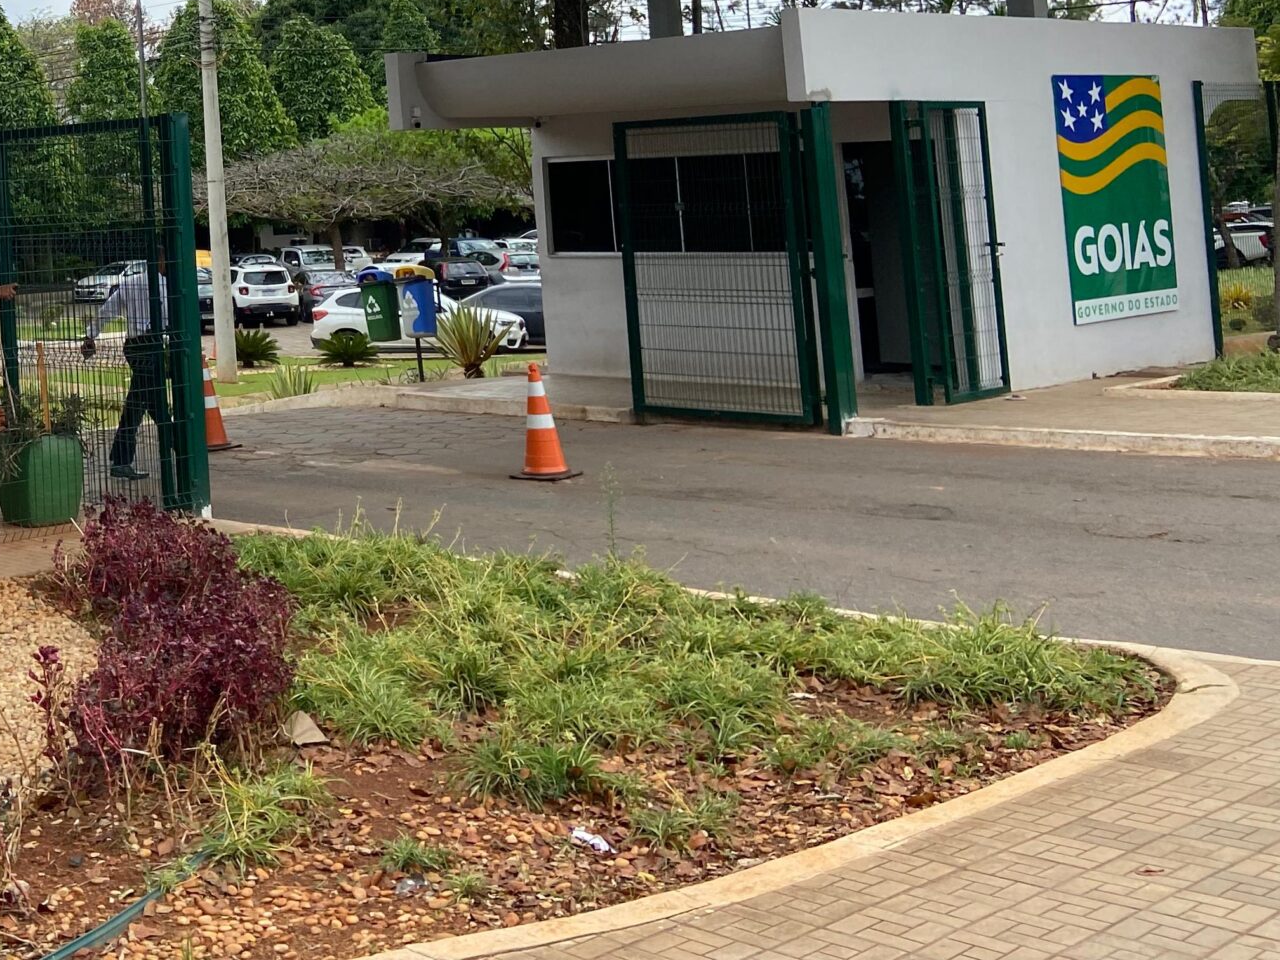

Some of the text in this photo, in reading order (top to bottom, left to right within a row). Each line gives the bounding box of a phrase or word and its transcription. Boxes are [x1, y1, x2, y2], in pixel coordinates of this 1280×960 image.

[1074, 218, 1172, 276] GOIÁS
[1077, 294, 1178, 318] GOVERNO DO ESTADO
